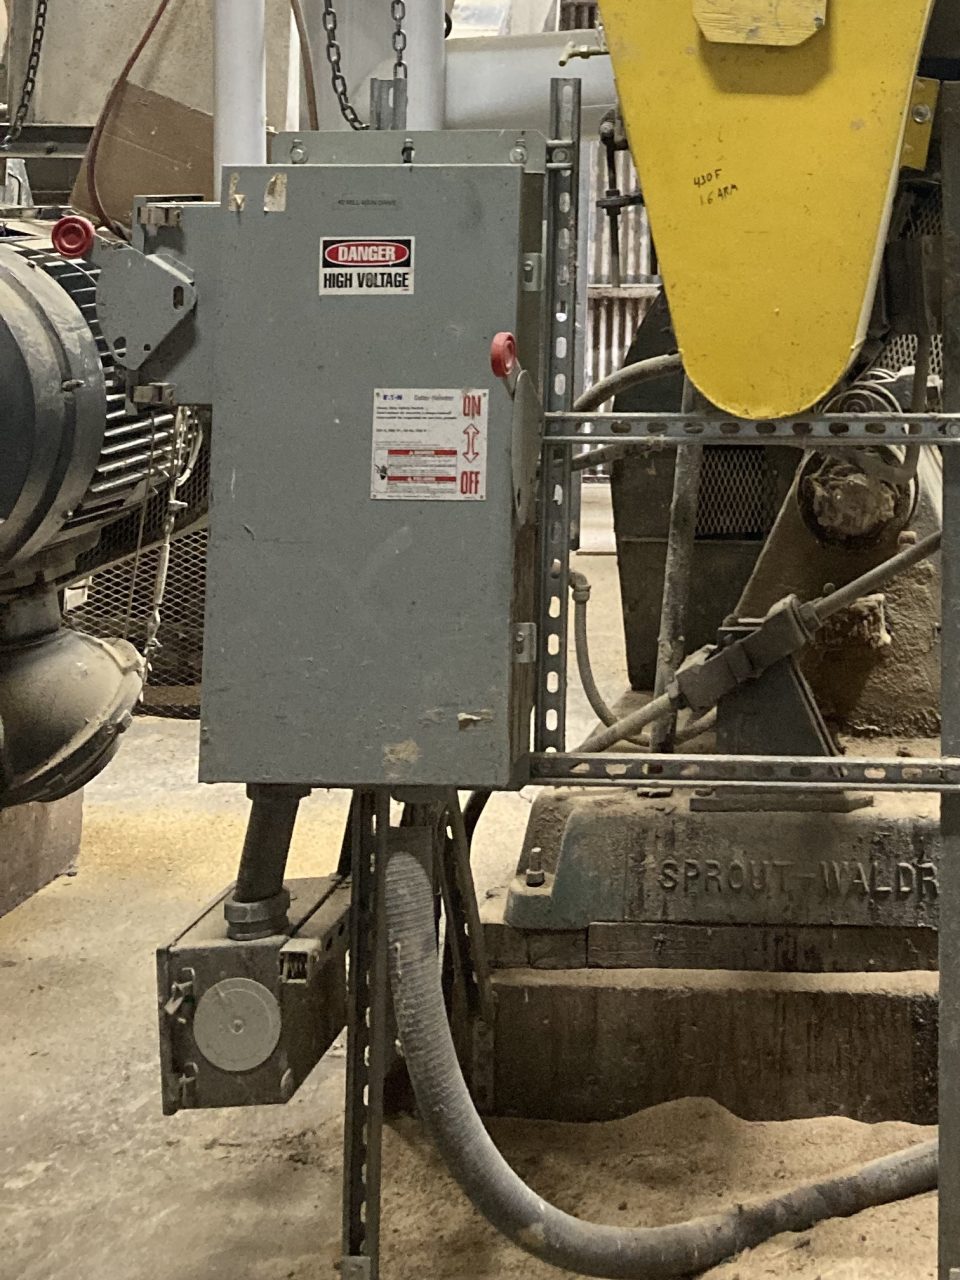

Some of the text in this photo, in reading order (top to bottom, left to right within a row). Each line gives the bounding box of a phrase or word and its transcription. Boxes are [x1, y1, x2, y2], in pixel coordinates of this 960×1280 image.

[337, 245, 396, 262] DANGER
[323, 272, 410, 289] HIGH VOLTAGE
[462, 394, 481, 417] ON
[460, 470, 481, 495] OFF
